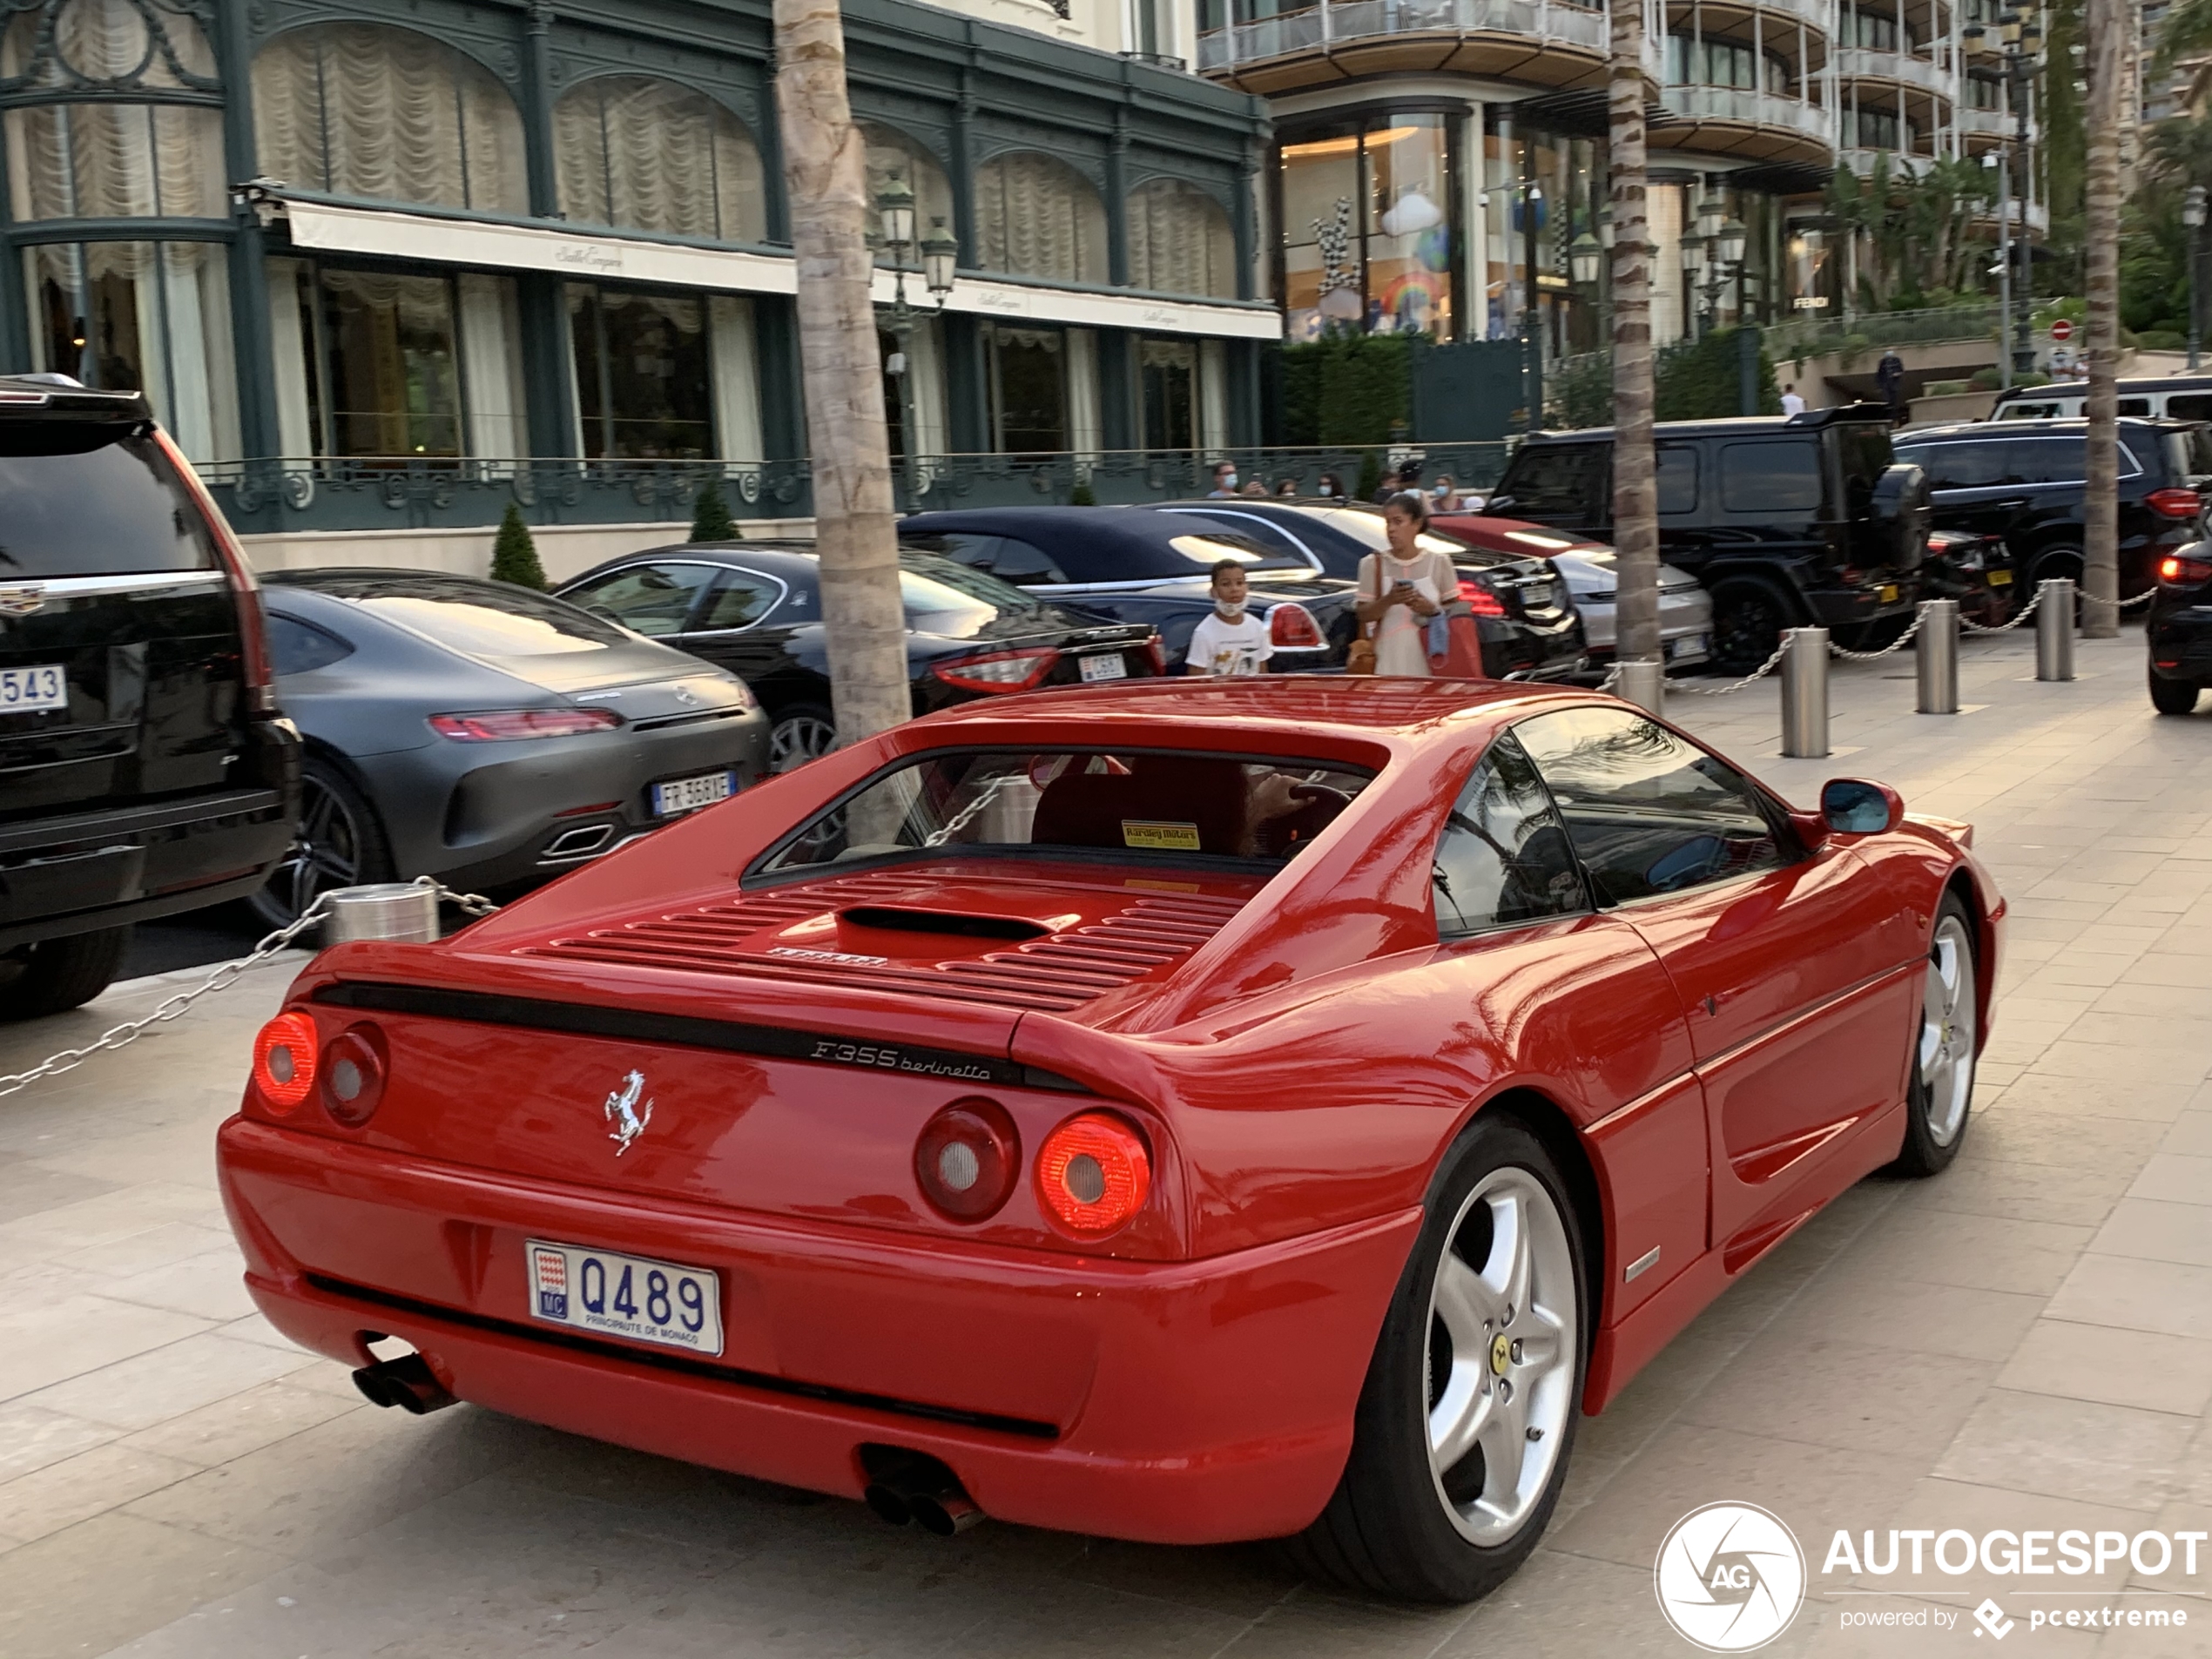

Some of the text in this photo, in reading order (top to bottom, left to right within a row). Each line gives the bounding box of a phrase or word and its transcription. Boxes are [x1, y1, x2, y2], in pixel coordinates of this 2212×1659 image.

[1793, 297, 1829, 309] FENDI
[0, 670, 58, 702] 543
[810, 1041, 991, 1080] F355 berlinetta
[543, 1294, 563, 1314] MC
[581, 1258, 704, 1332] Q489
[645, 1325, 658, 1336] DE
[660, 1328, 699, 1345] MONACO
